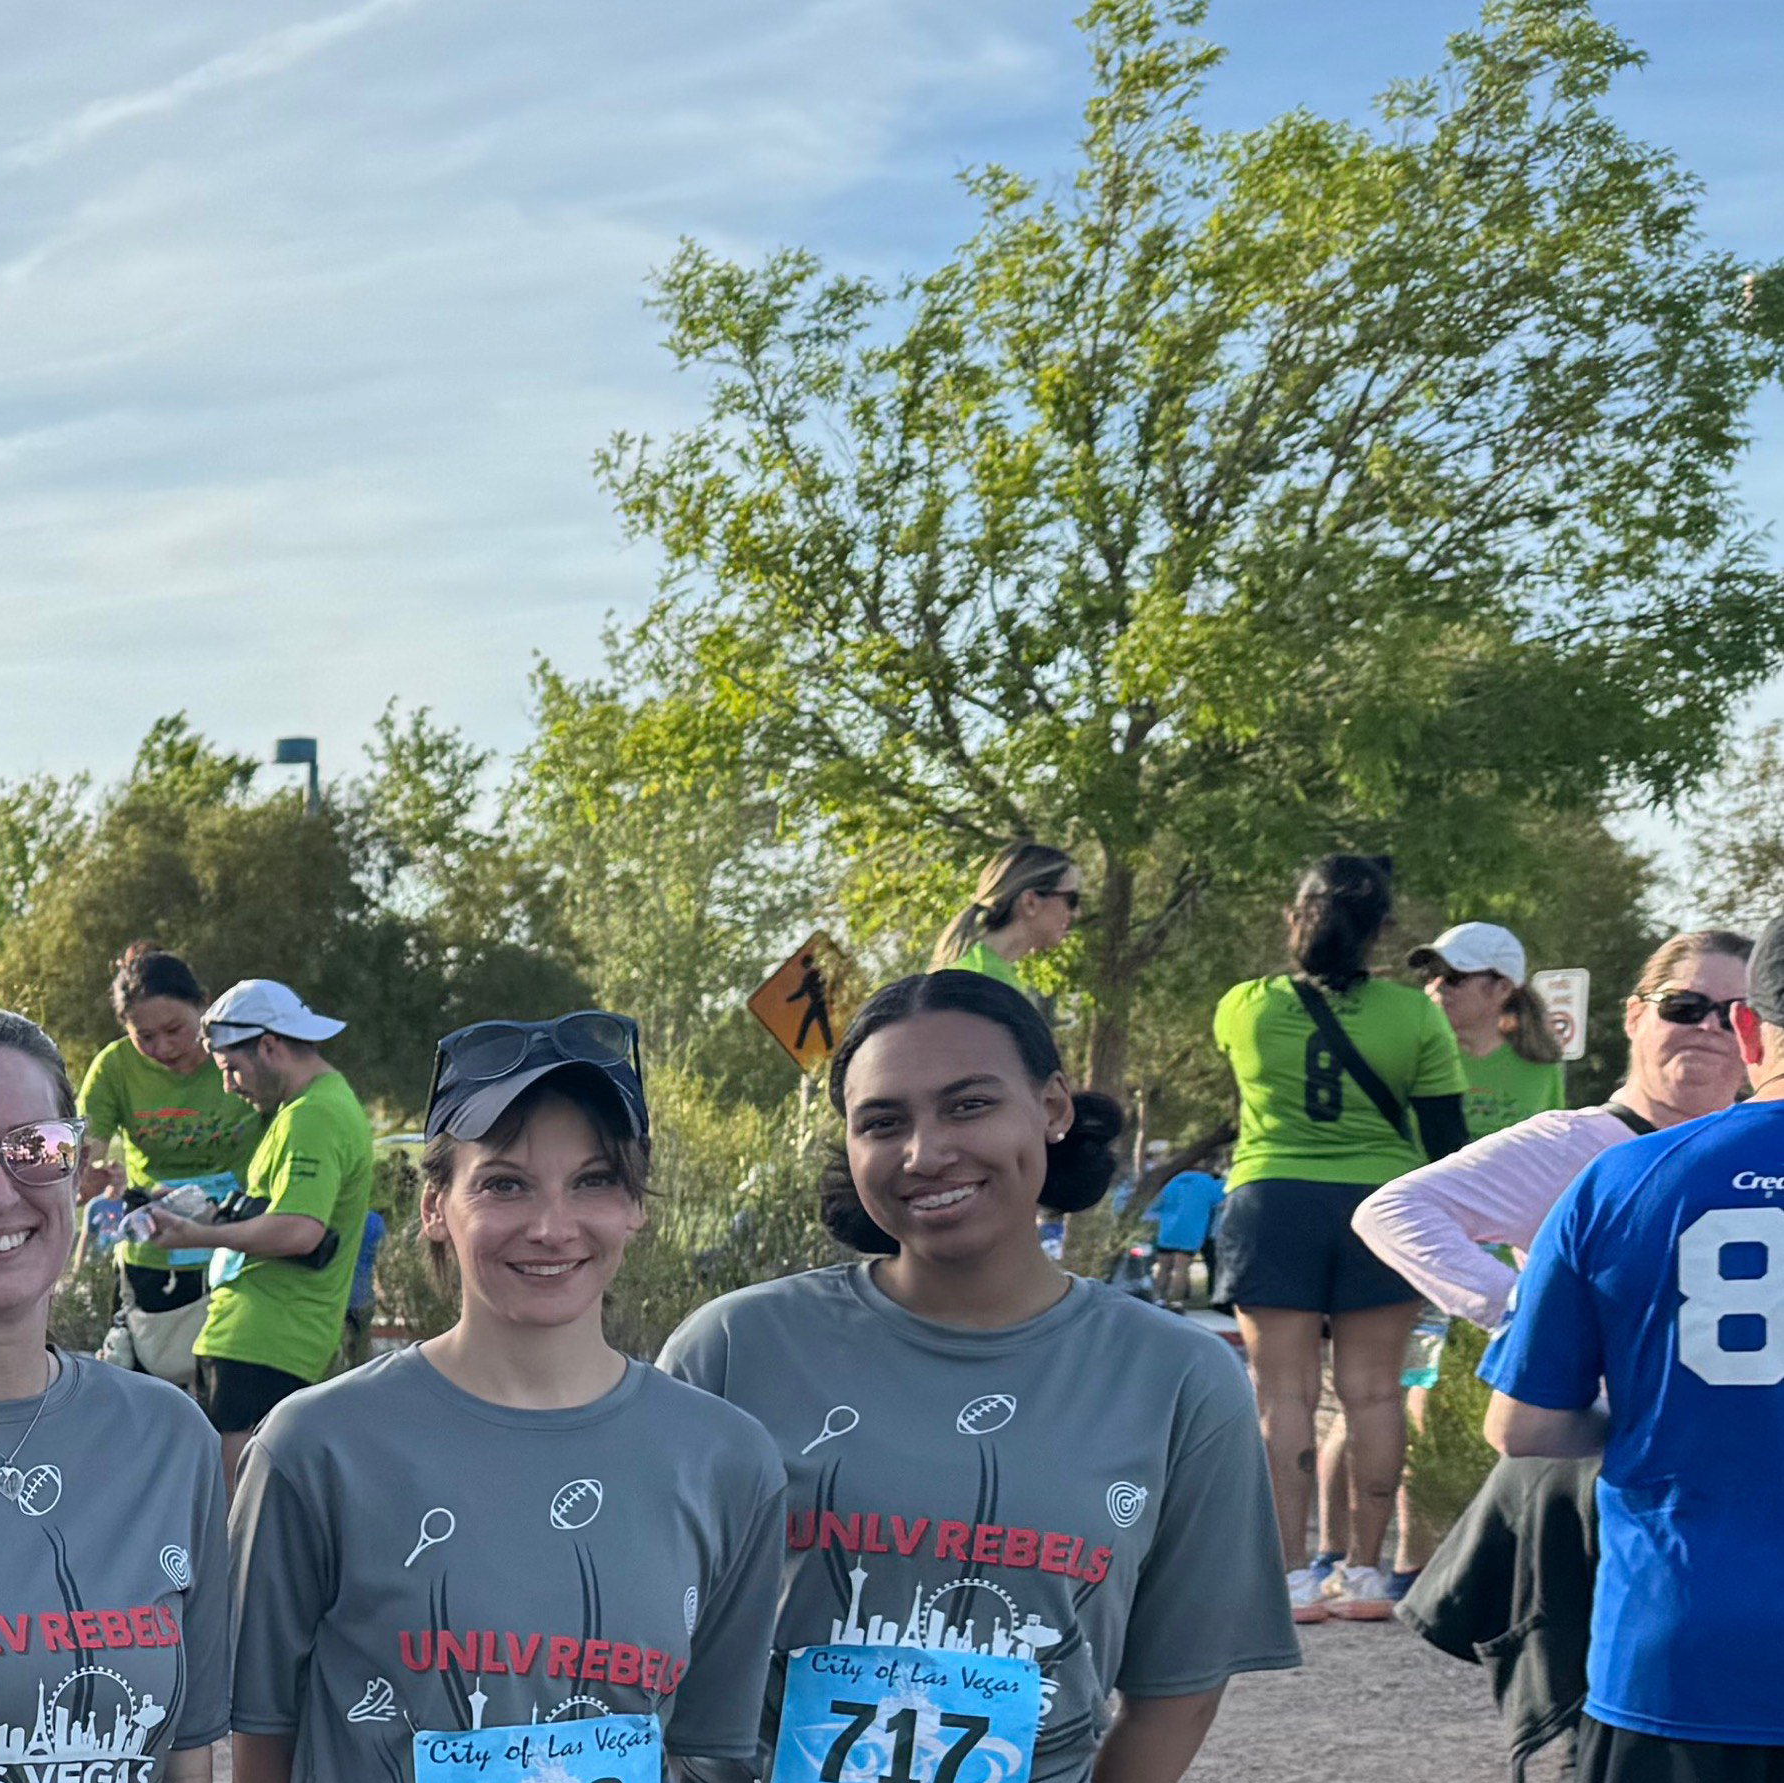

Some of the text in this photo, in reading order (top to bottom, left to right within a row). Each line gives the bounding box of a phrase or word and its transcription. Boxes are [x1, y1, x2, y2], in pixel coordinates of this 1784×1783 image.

[1304, 1029, 1342, 1122] 8
[1679, 1207, 1784, 1386] 8
[787, 1509, 1113, 1584] UNLV REBELS
[42, 1602, 181, 1653] REBELS
[398, 1630, 687, 1696] UNLV REBELS
[812, 1651, 1020, 1699] City of Las Vegas
[430, 1727, 652, 1771] City of Las Vegas
